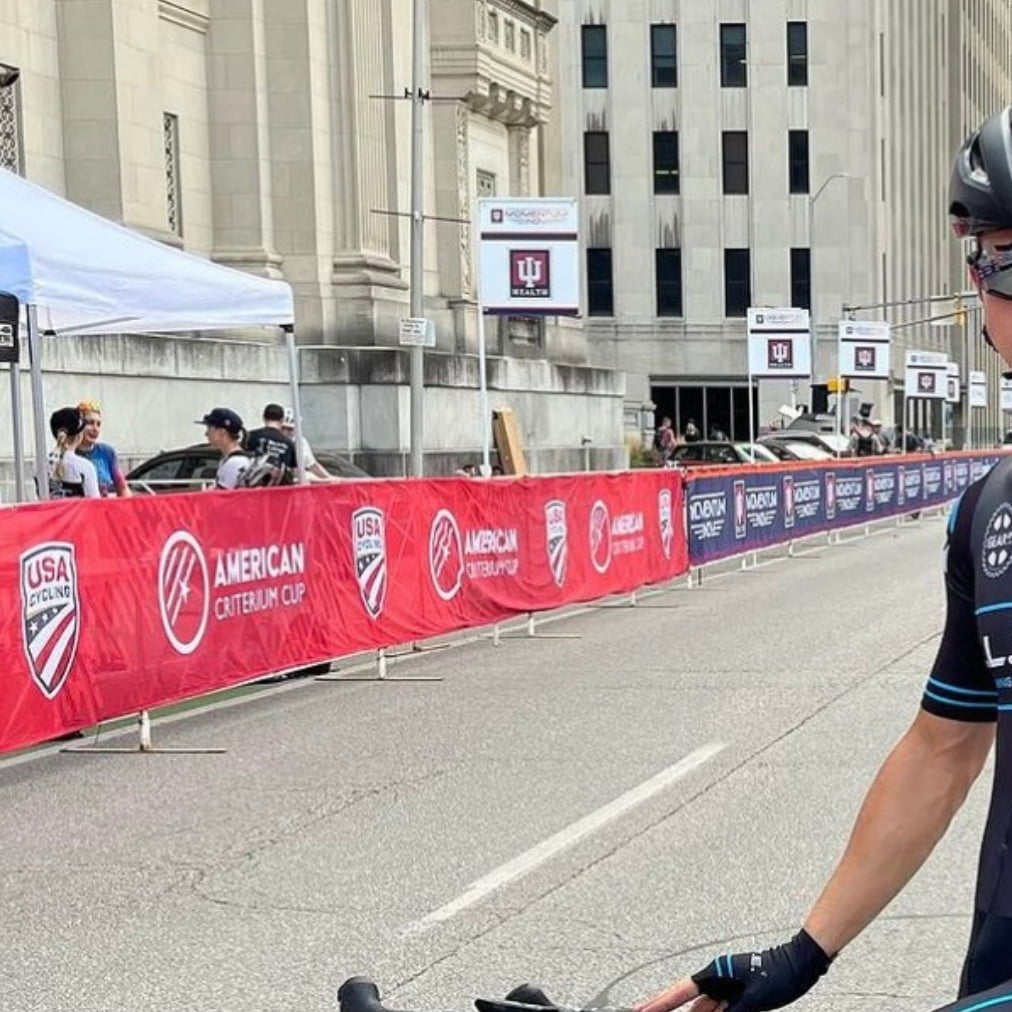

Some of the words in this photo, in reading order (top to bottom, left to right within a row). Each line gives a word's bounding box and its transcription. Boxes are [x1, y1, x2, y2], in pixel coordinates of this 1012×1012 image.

[357, 517, 380, 539] USA
[465, 528, 518, 555] AMERICAN
[27, 556, 69, 589] USA
[214, 543, 306, 588] AMERICAN
[29, 585, 71, 606] CYCLING
[214, 590, 278, 621] CRITERIUM
[281, 582, 306, 606] CUP
